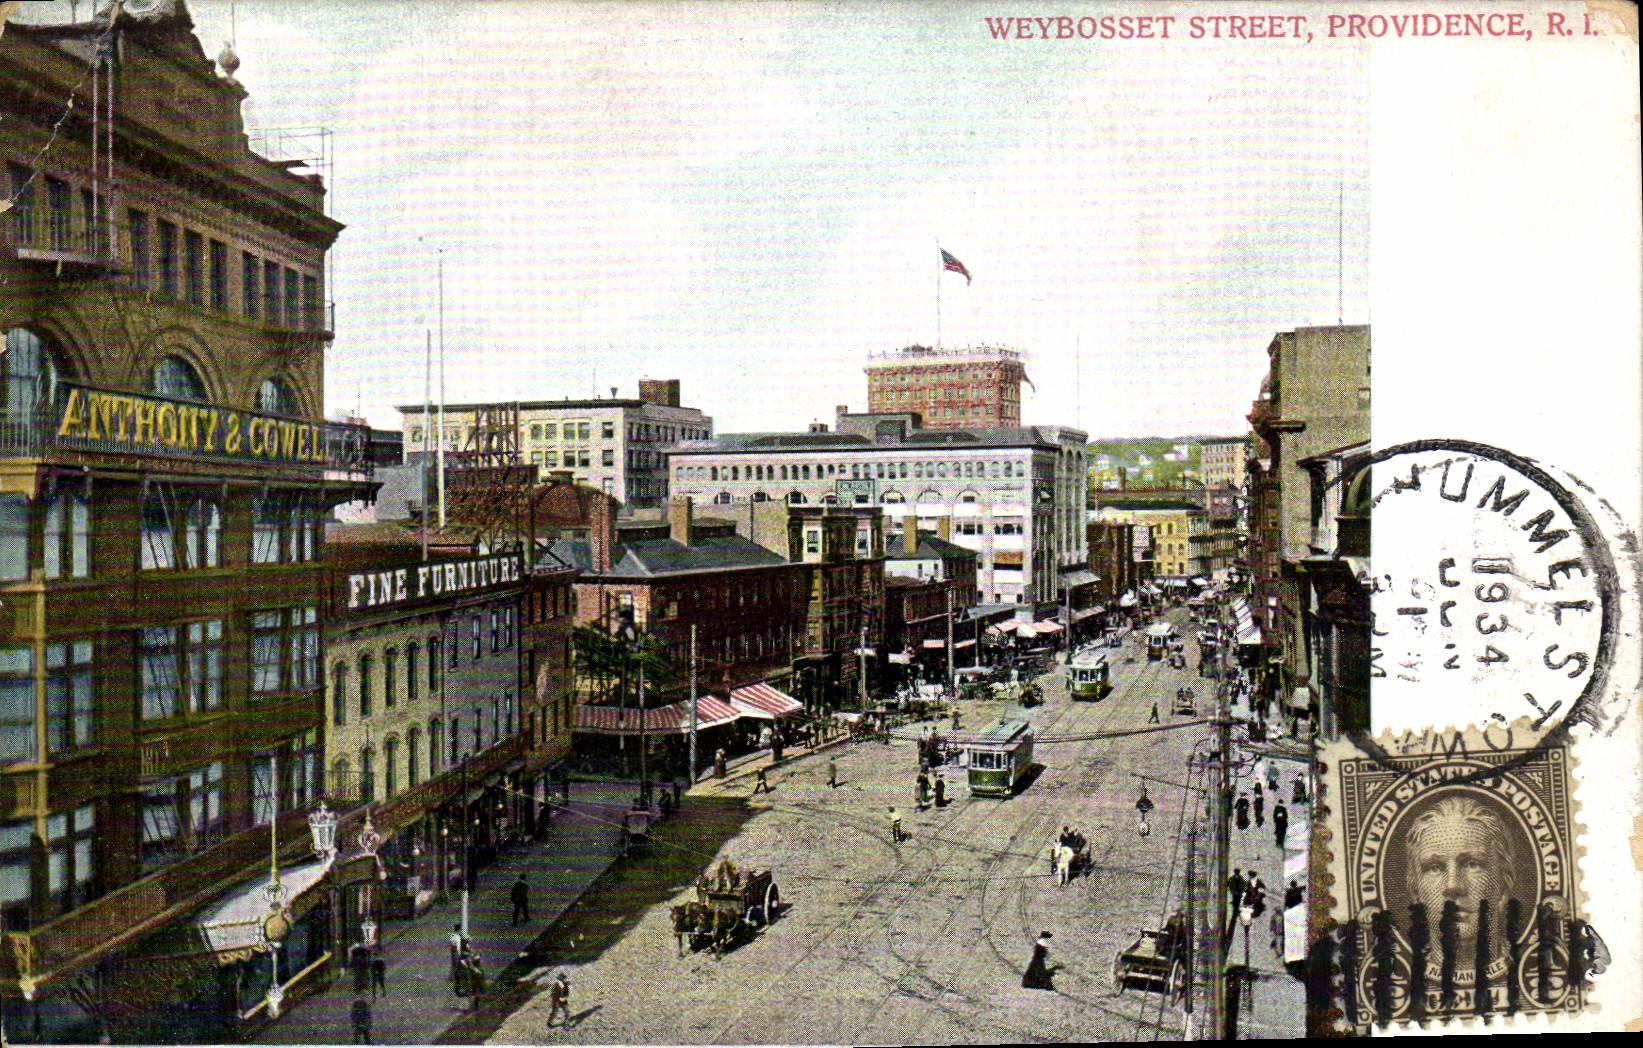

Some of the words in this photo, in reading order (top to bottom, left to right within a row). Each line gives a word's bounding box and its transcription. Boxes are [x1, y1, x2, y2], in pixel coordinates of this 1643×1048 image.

[58, 389, 218, 453] ANTHONY
[225, 412, 243, 454] &
[348, 568, 407, 608] FINE
[417, 556, 519, 598] FURNITURE
[1472, 557, 1512, 667] 1934
[1361, 800, 1399, 902] UNITED
[1493, 776, 1562, 892] POSTAGE
